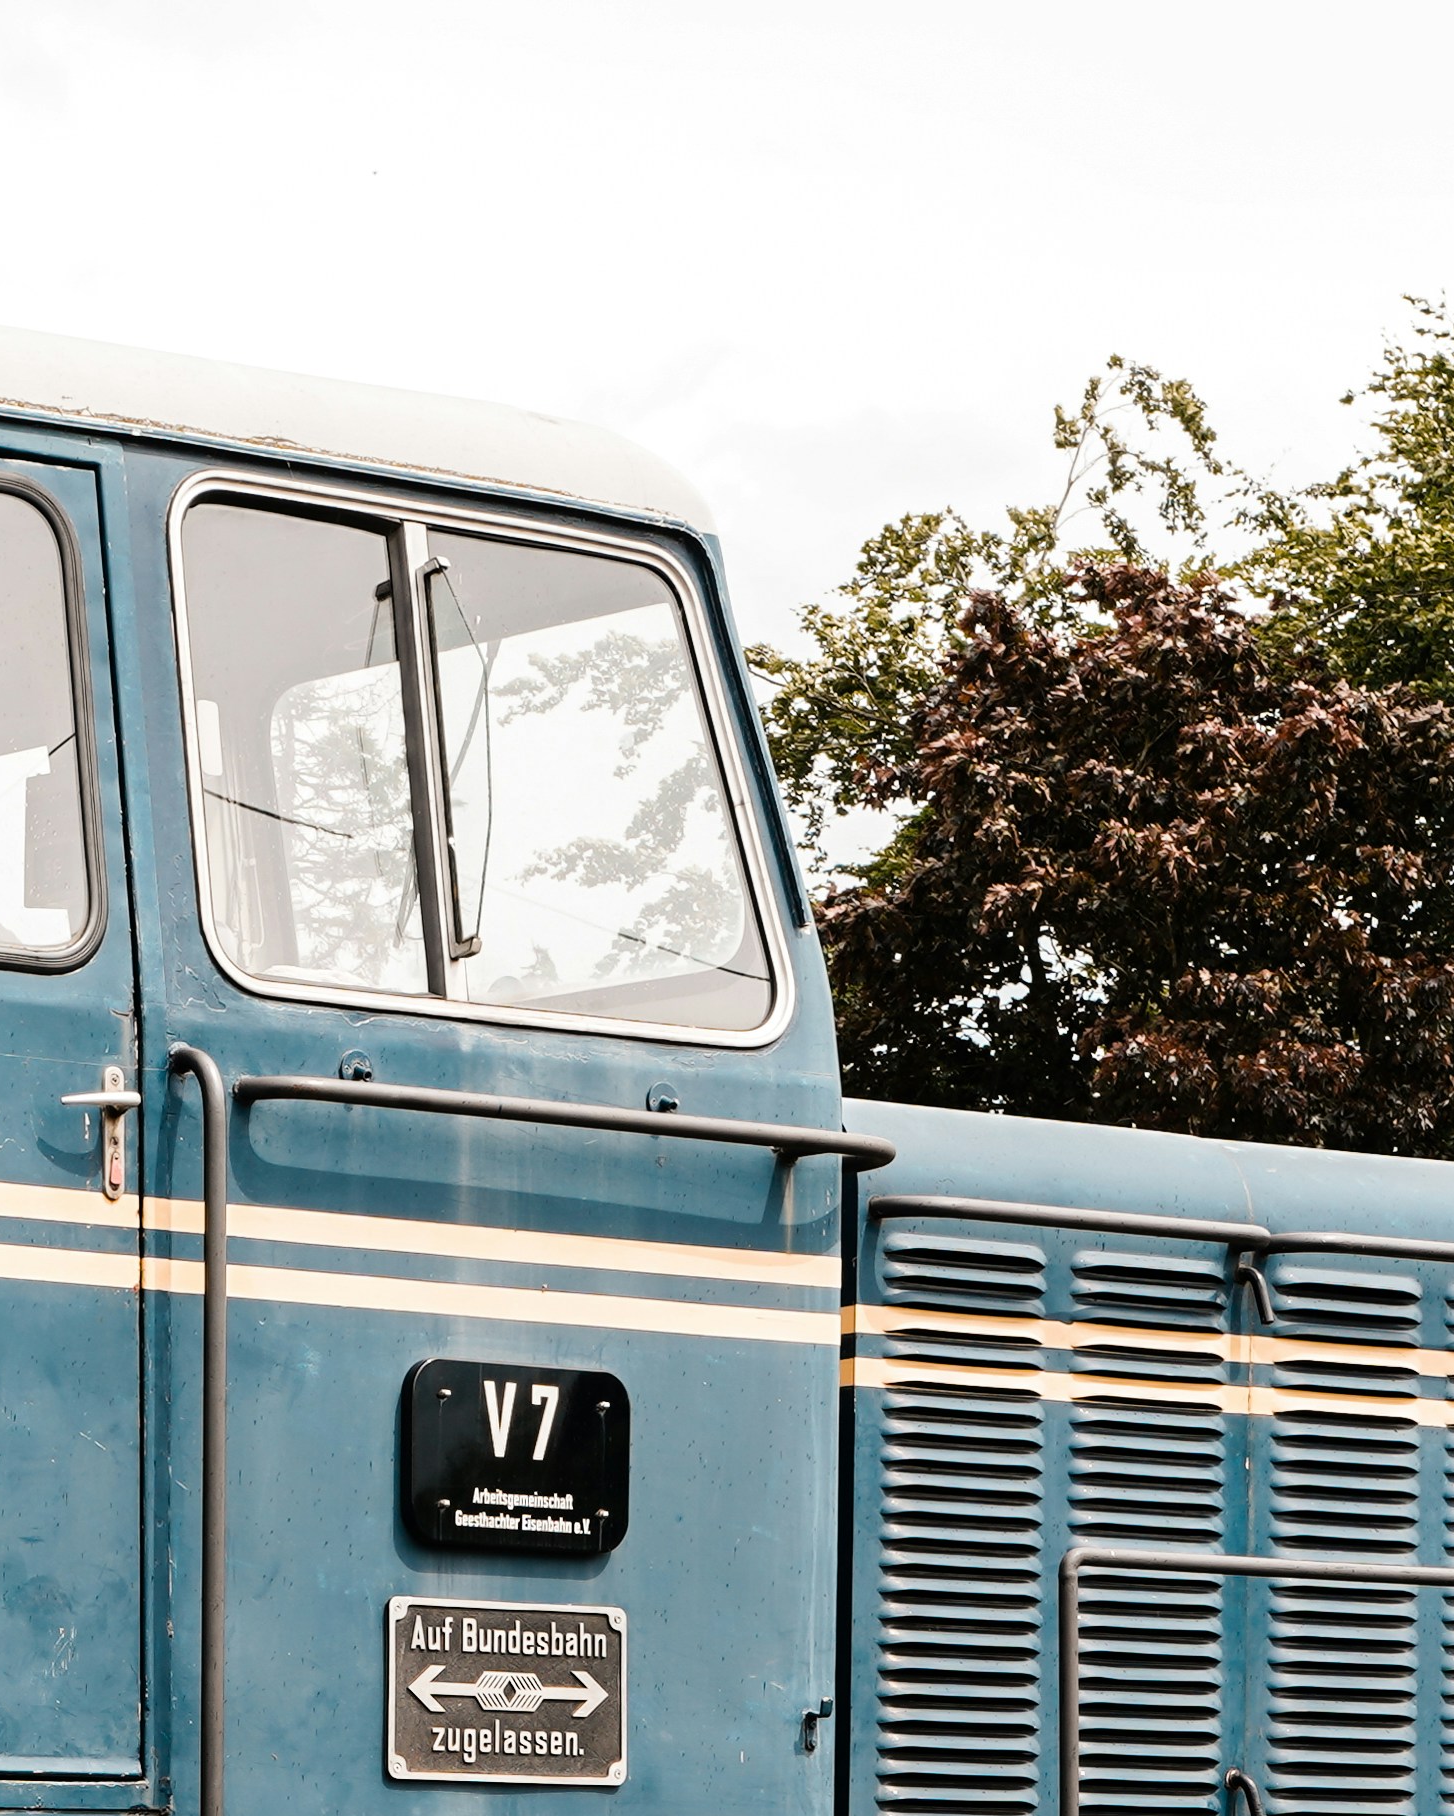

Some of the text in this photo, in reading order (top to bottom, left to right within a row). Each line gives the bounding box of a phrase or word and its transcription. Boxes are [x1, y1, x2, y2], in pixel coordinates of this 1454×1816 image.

[483, 1380, 559, 1461] V 7
[473, 1487, 574, 1510] Arbeitsgemeinschaft
[455, 1510, 591, 1535] Geesthachter Eisenbahn e.V.
[410, 1615, 608, 1659] Auf Bundesbahn
[431, 1719, 585, 1764] zugelassen.
